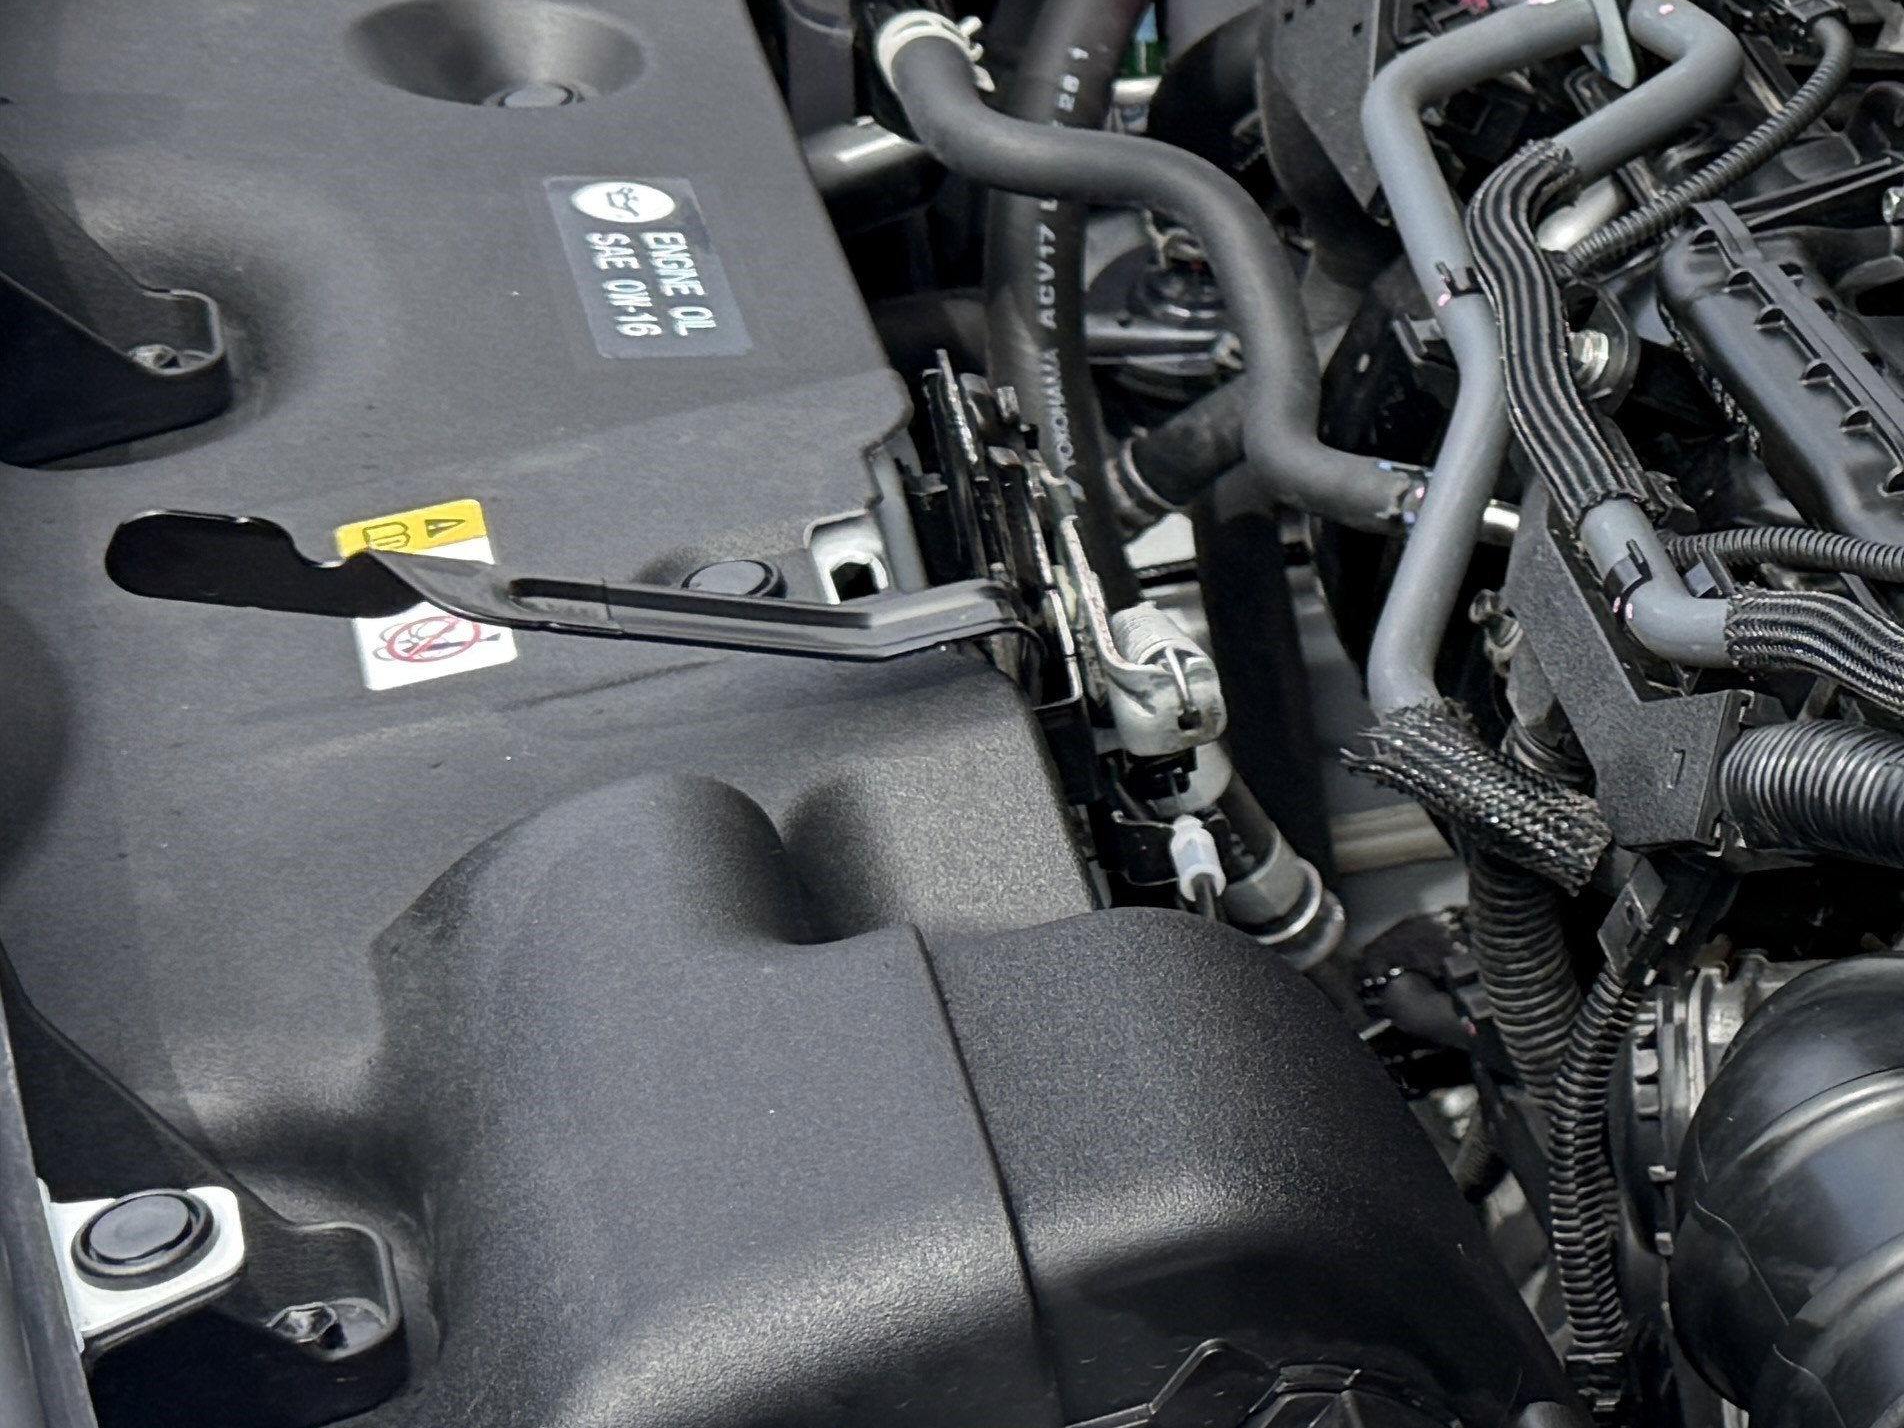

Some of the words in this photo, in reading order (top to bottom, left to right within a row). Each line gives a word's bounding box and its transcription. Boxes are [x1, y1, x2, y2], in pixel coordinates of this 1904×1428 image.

[585, 232, 642, 270] SAE
[639, 232, 706, 297] ENGINE
[1035, 221, 1058, 330] ACV17
[602, 279, 664, 337] 0W-16
[667, 306, 717, 337] OIL
